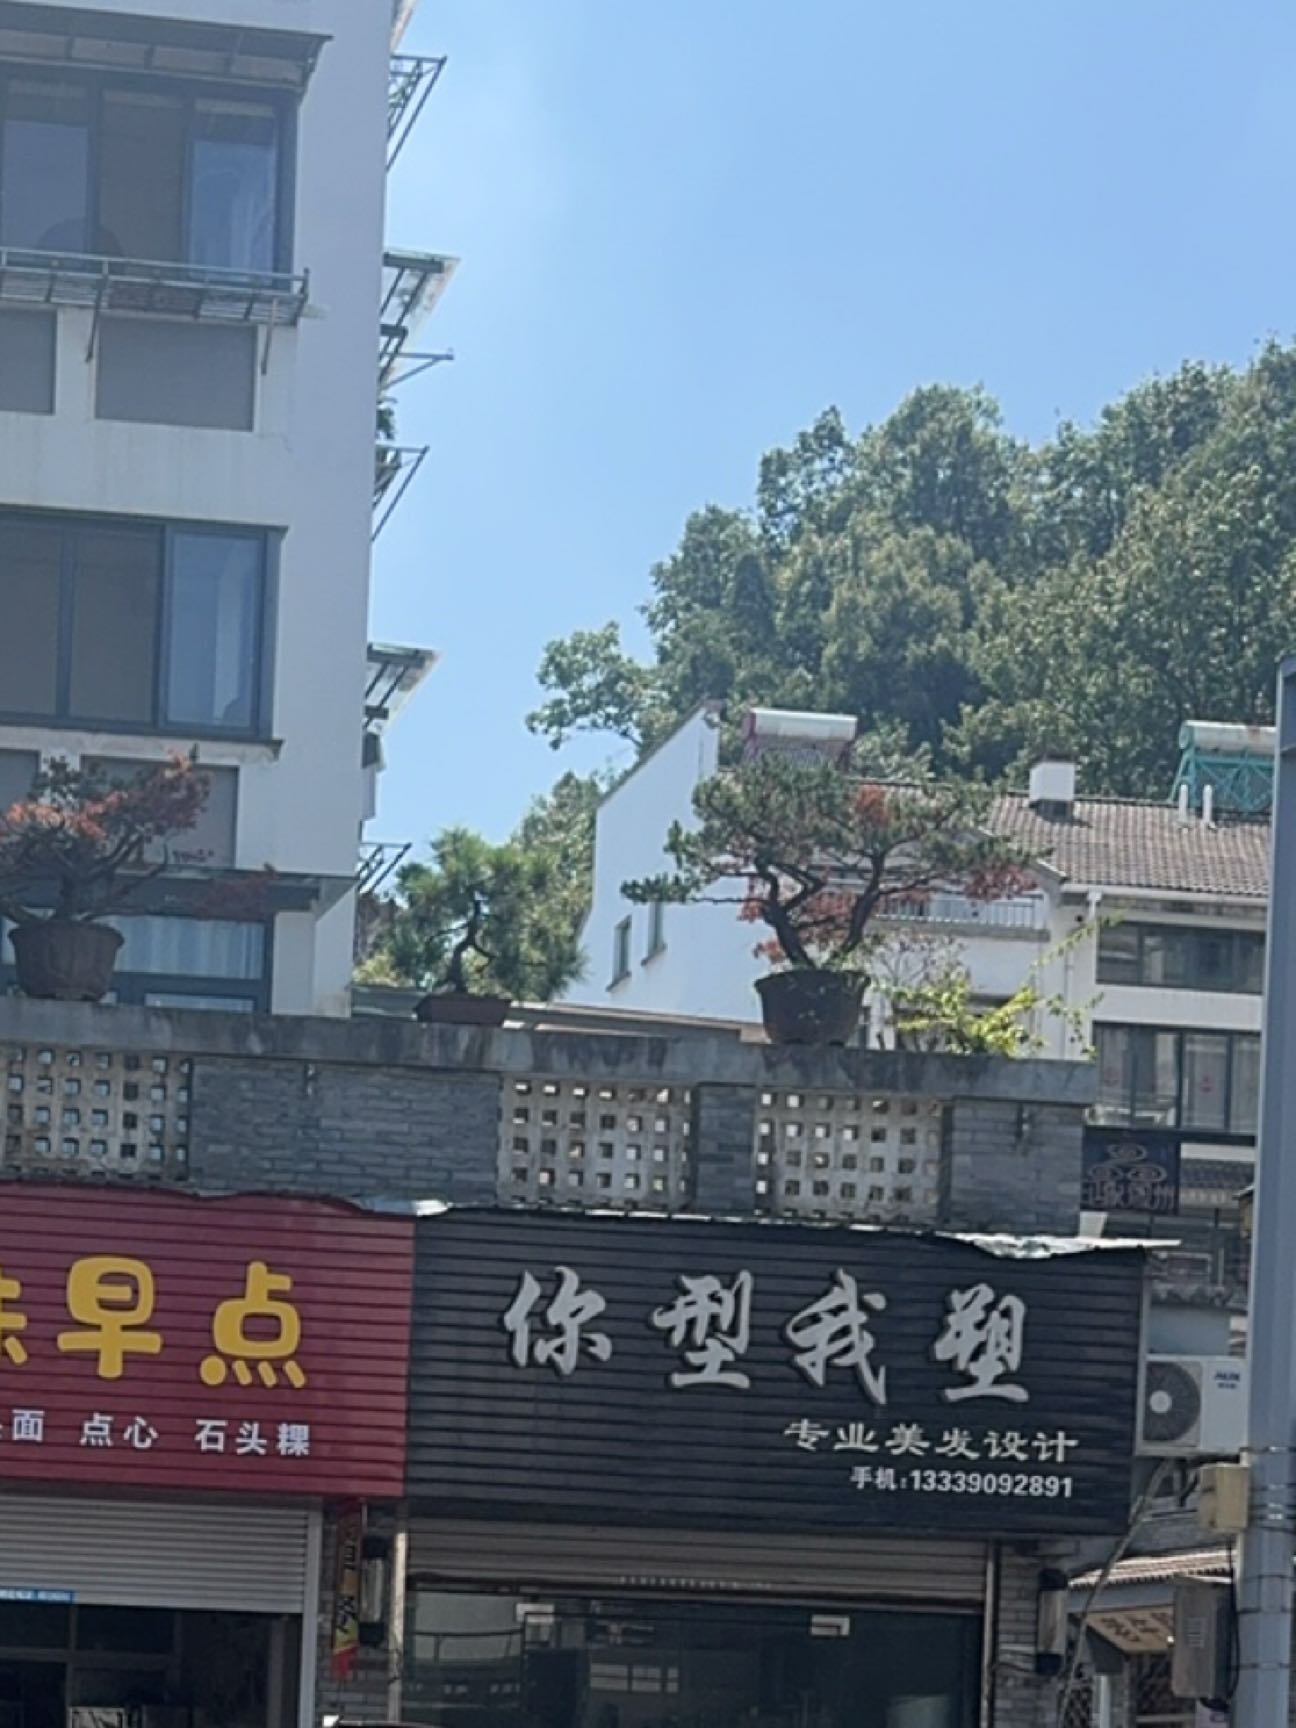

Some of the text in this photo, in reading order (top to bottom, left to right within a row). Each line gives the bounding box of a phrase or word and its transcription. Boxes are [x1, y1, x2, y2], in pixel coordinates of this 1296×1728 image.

[503, 1265, 1030, 1405] 你型我塑
[79, 1412, 159, 1449] 点心
[194, 1418, 311, 1456] 石头粿
[783, 1418, 1079, 1463] 专业美发设计
